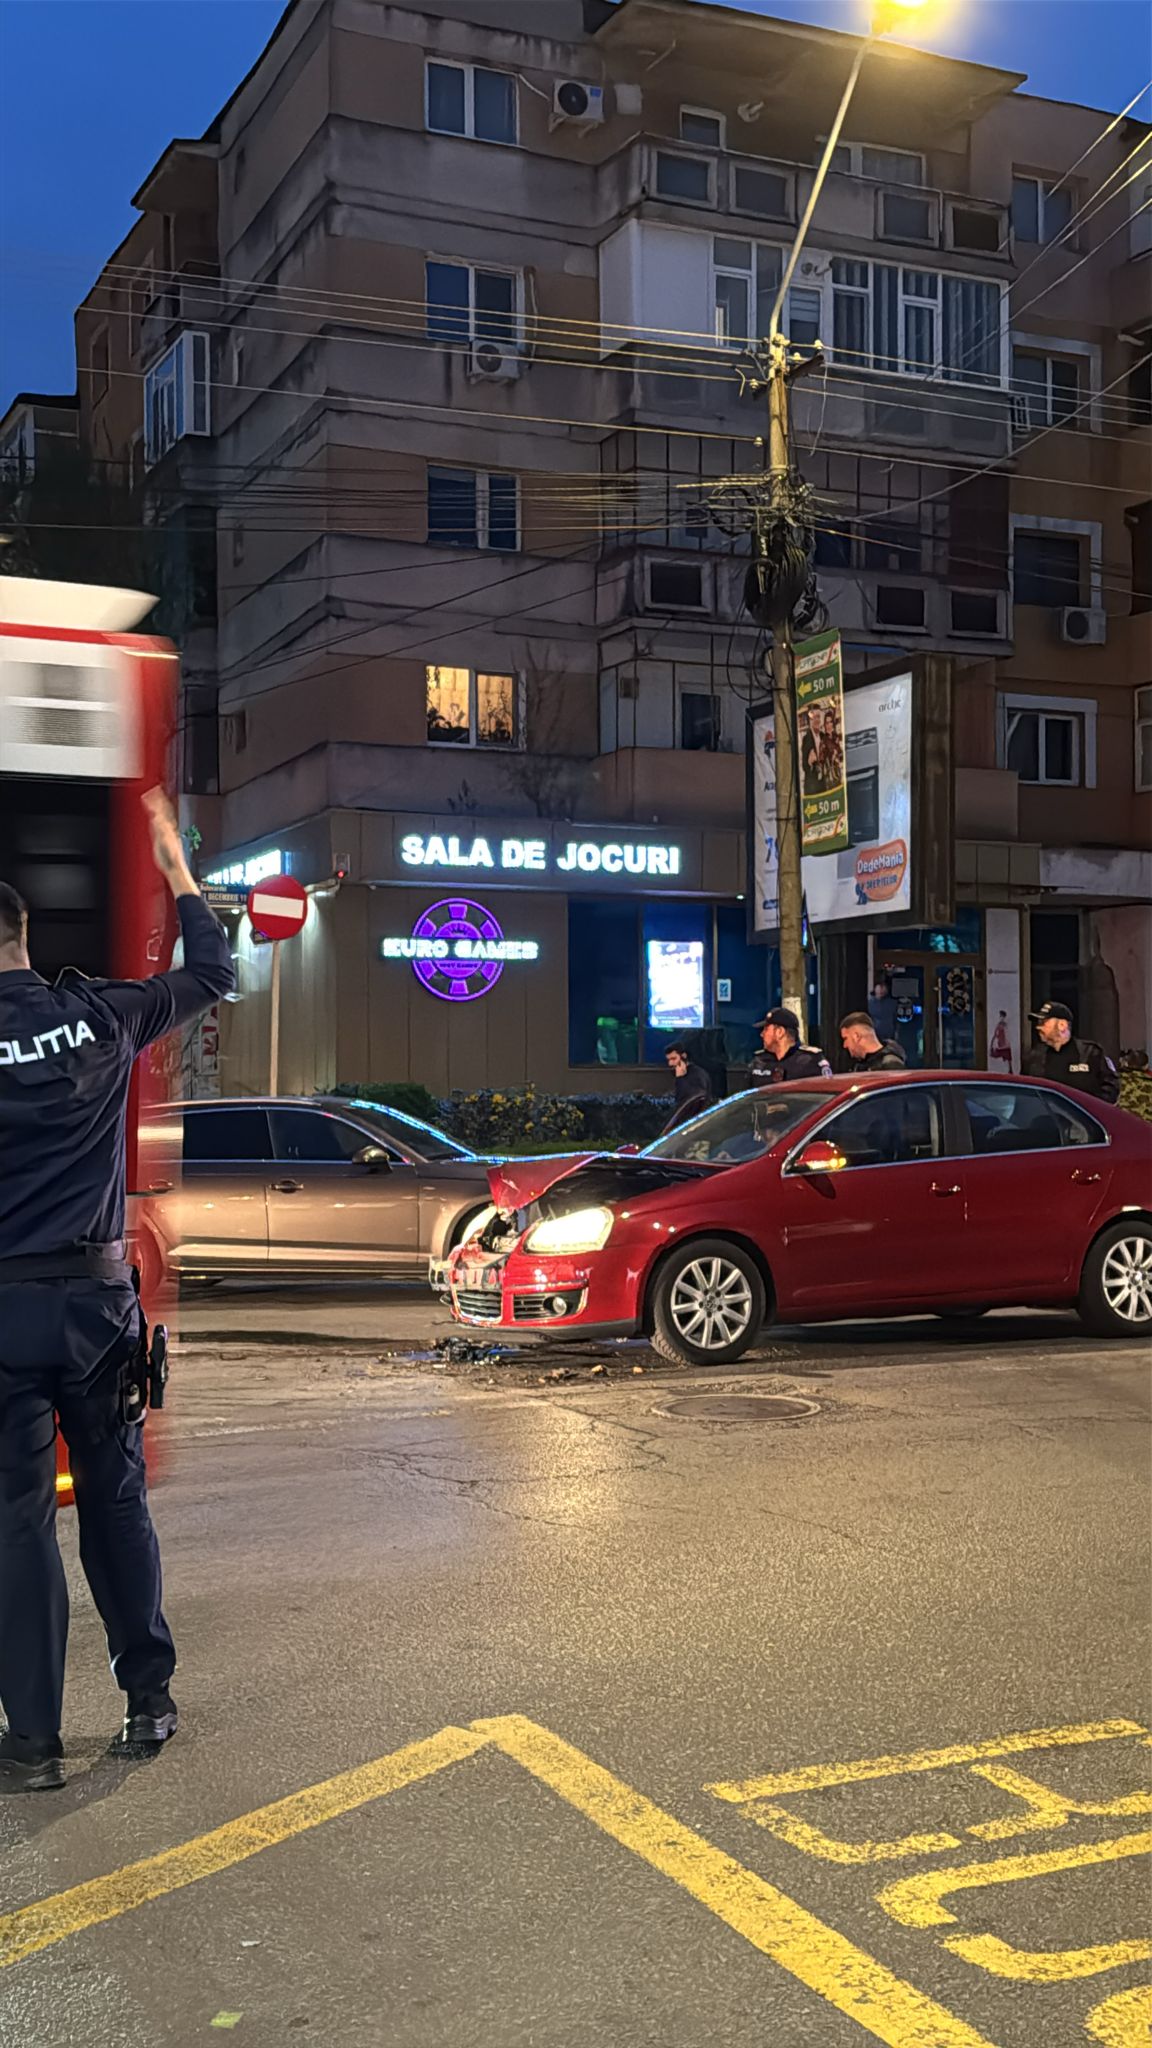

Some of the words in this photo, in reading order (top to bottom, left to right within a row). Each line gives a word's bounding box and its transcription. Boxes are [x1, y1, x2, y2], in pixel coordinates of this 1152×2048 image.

[813, 678, 825, 693] 50
[826, 676, 835, 688] m
[818, 800, 829, 815] 50
[831, 800, 840, 812] m
[401, 835, 494, 867] SALA
[502, 839, 545, 869] DE
[557, 842, 679, 874] JOCURI
[383, 938, 449, 958] EURO
[454, 939, 538, 959] GAMES
